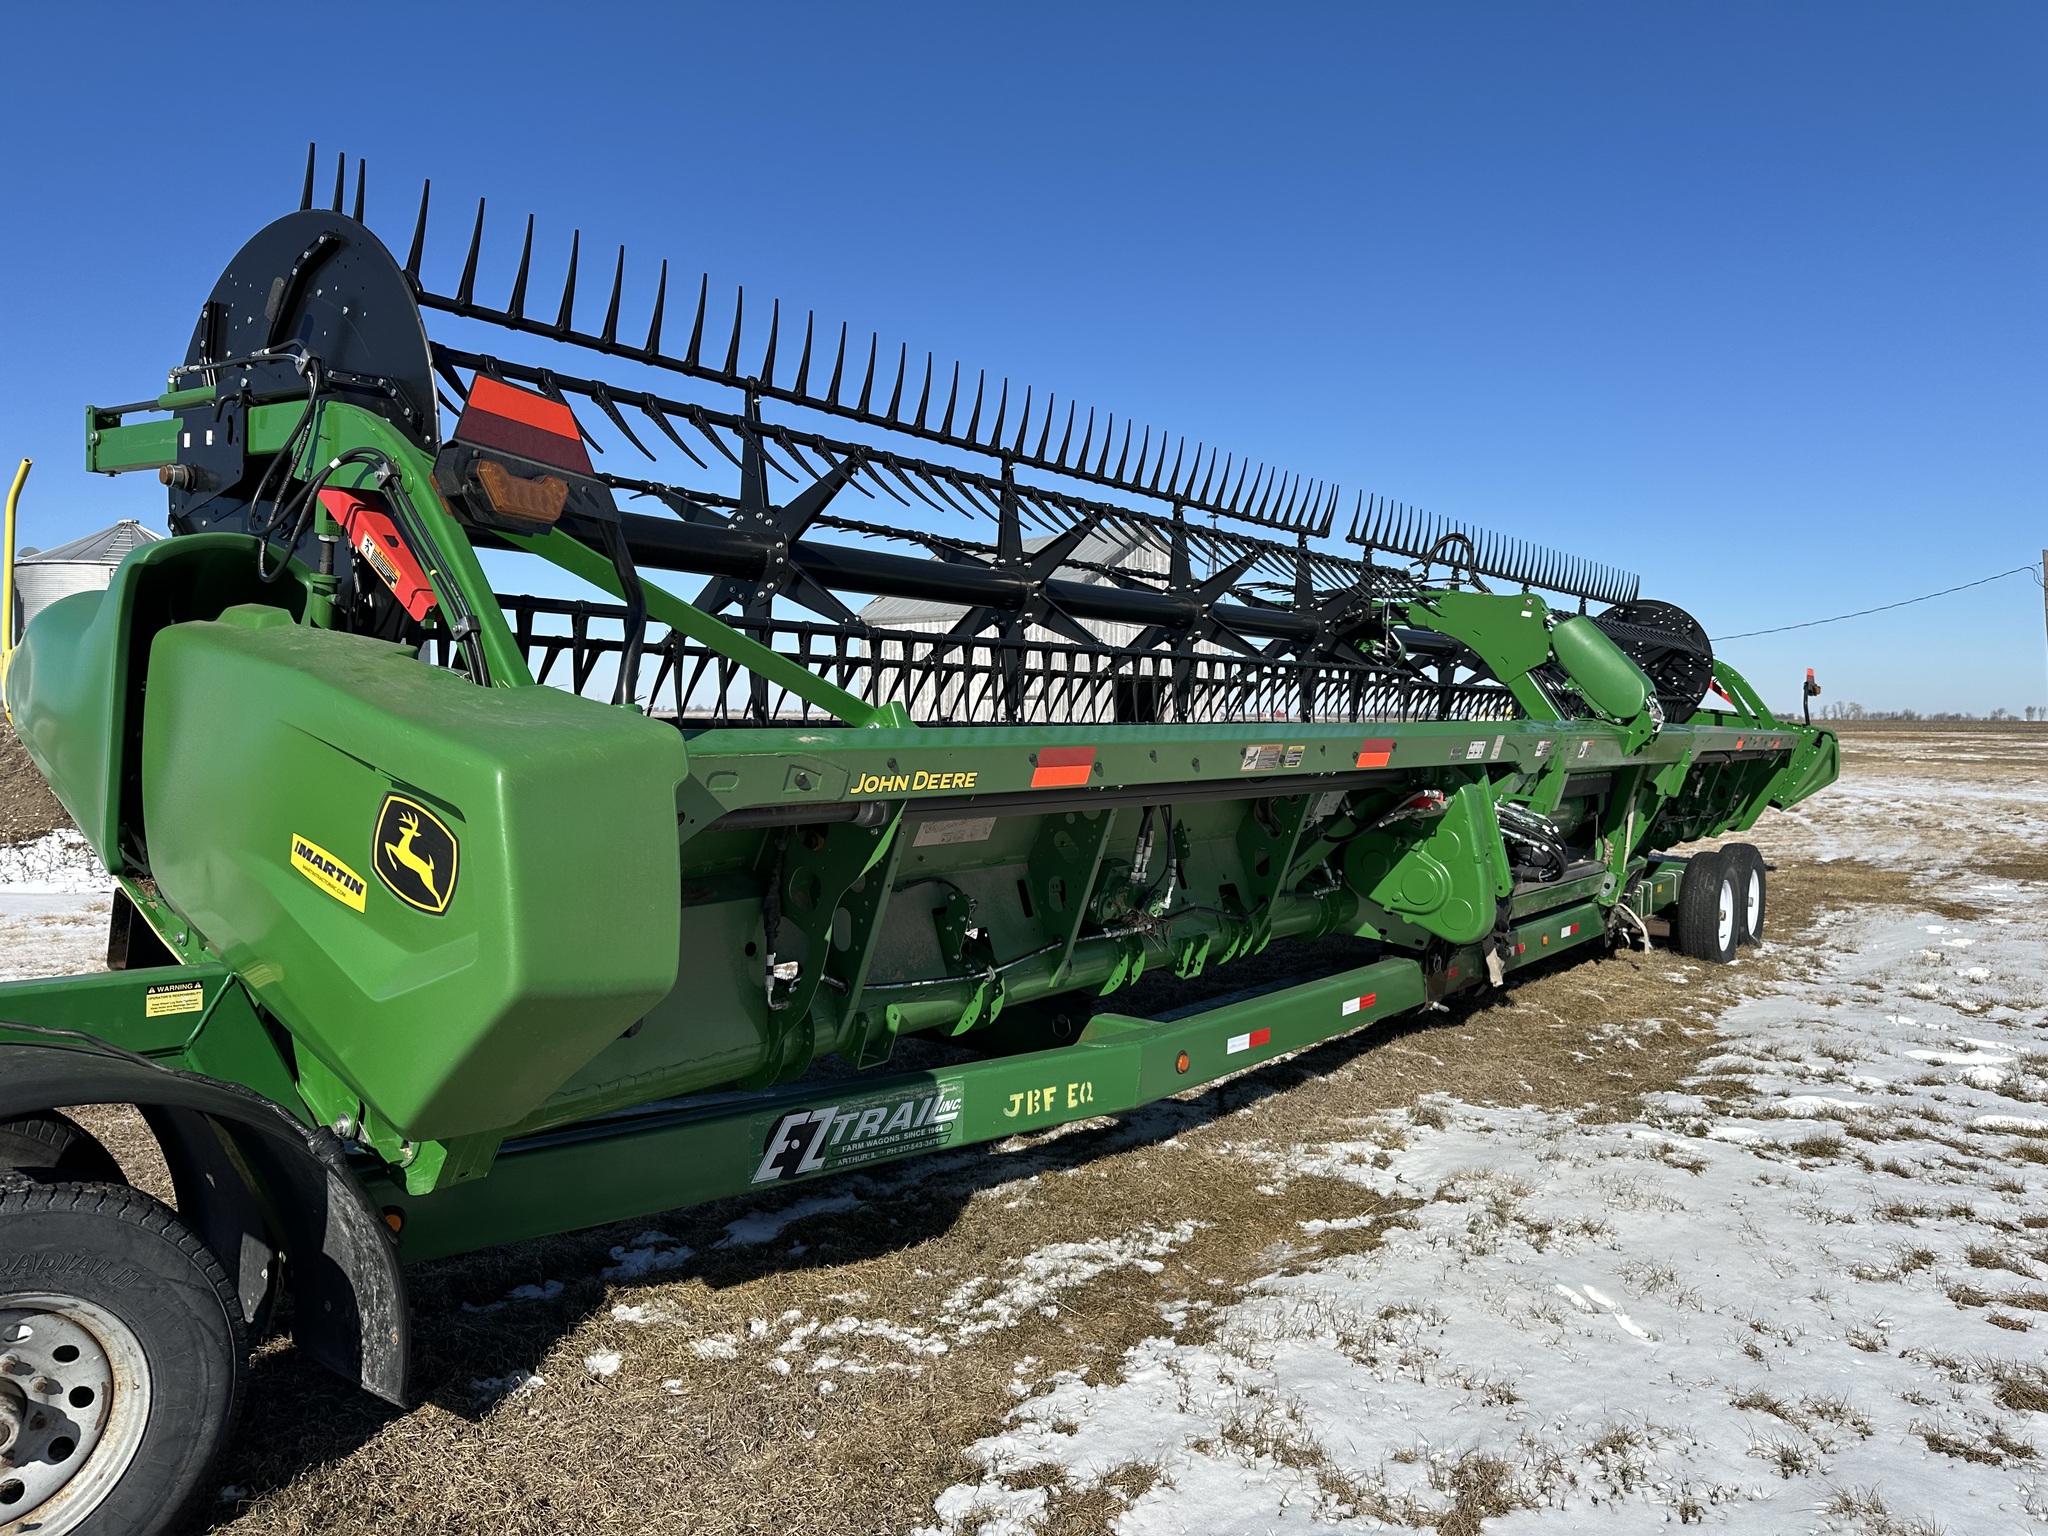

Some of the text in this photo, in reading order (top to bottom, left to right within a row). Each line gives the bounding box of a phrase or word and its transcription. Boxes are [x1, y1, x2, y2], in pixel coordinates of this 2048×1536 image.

[850, 770, 978, 794] JOHN DEERE
[294, 841, 364, 896] MARTIN
[157, 983, 193, 993] WARNING
[1002, 1081, 1094, 1118] JBF EQ
[829, 1095, 959, 1146] TRAIL
[841, 1125, 944, 1154] FARM WAGONS SINCE 1964
